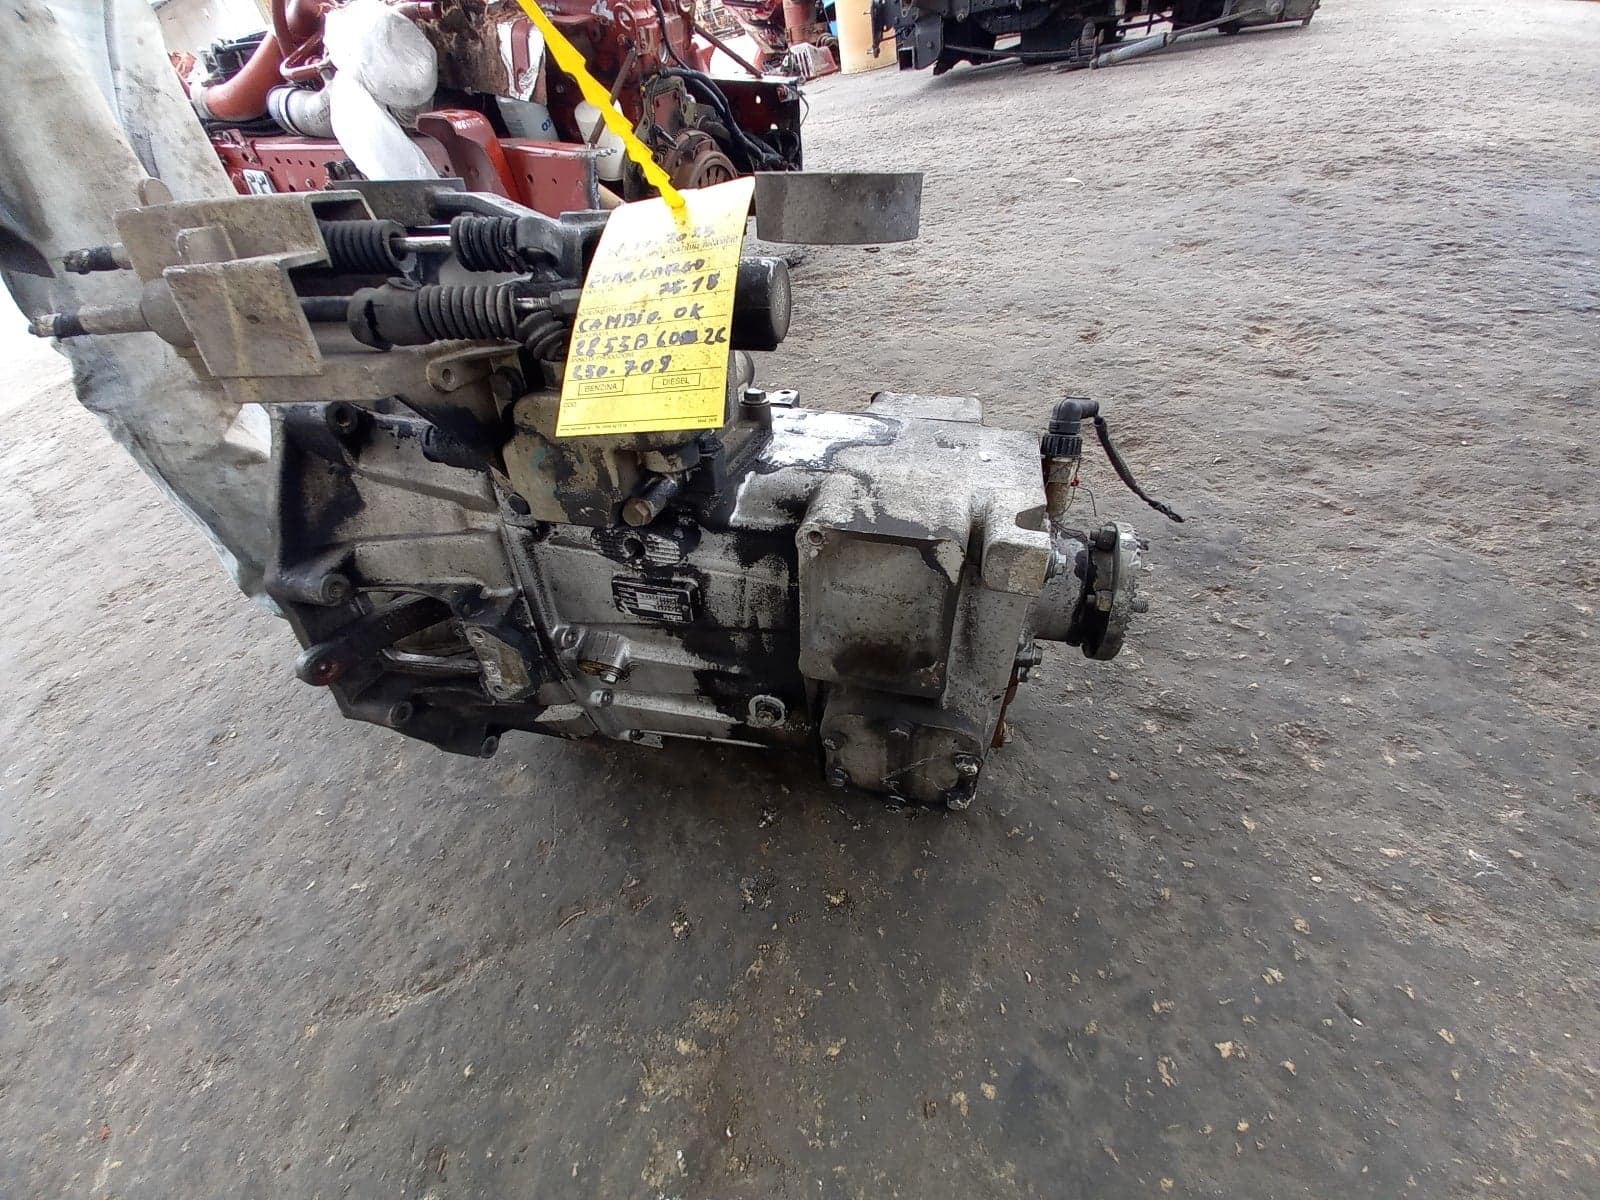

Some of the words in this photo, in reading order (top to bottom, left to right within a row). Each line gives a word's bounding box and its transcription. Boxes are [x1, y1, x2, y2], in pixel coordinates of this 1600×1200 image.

[673, 303, 705, 320] OK
[662, 376, 690, 386] DIESEL
[584, 383, 618, 393] BENZINA
